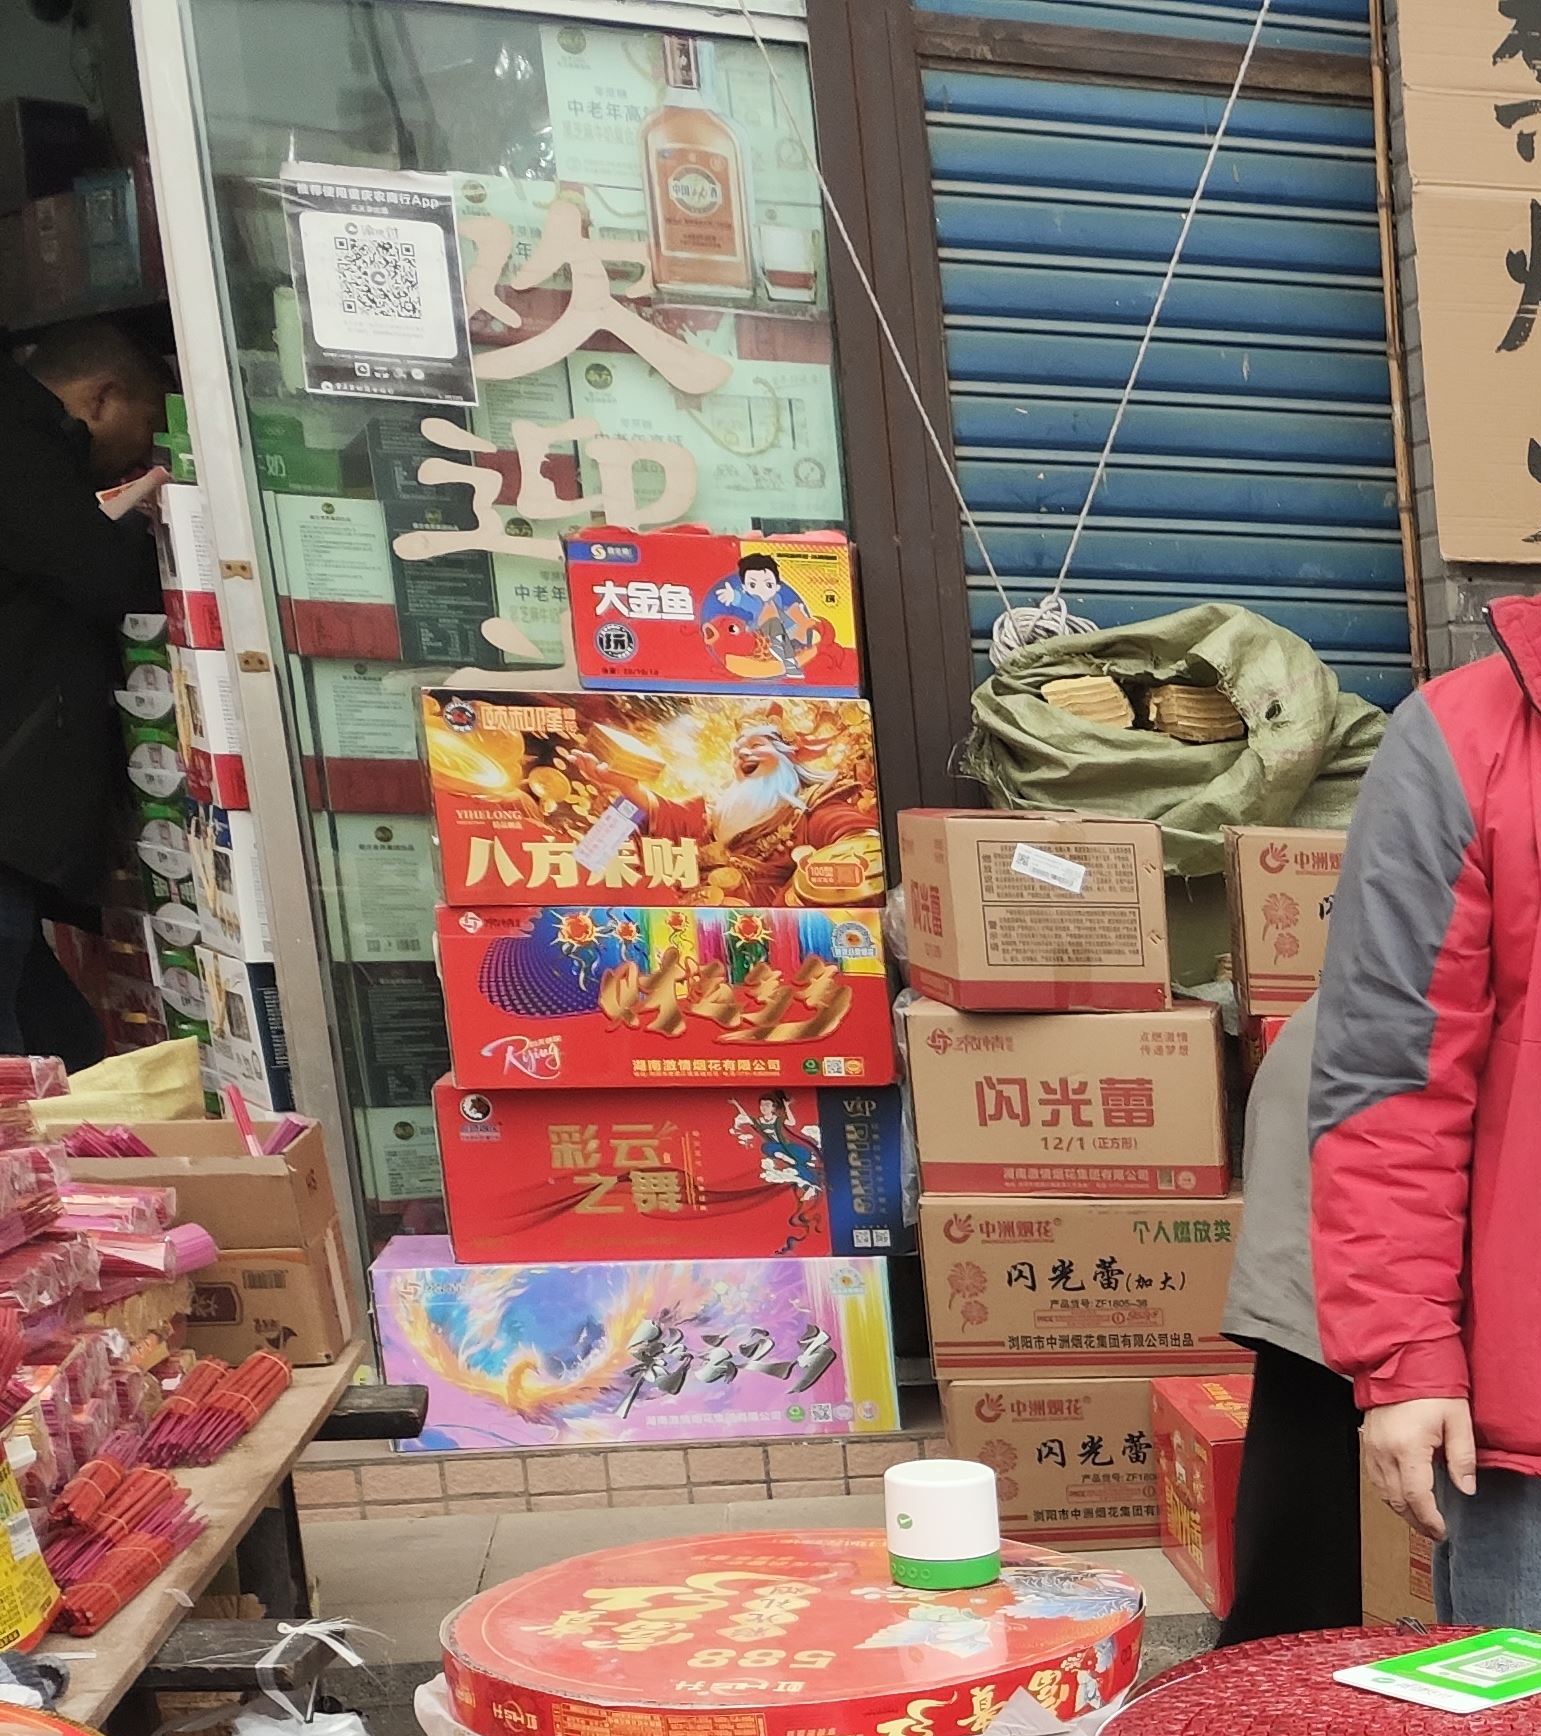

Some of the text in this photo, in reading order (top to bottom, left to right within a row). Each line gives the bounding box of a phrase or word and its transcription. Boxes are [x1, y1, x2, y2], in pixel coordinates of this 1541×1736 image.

[567, 99, 646, 122] 中老年高
[592, 580, 694, 621] 大金鱼
[455, 809, 522, 820] YIHELONG
[975, 1075, 1155, 1128] 闪光蕾
[547, 1119, 676, 1170] 彩云
[1040, 1136, 1086, 1152] 12/1
[573, 1169, 683, 1215] 之舞
[1133, 1219, 1232, 1245] 个人燃放类
[1007, 1332, 1194, 1350] 浏阳市中洲烟花集团有限公司出品
[1036, 1430, 1153, 1468] 闪光蕾
[1033, 1504, 1160, 1523] 浏阳市中洲烟花集团有
[686, 1648, 836, 1670] 588
